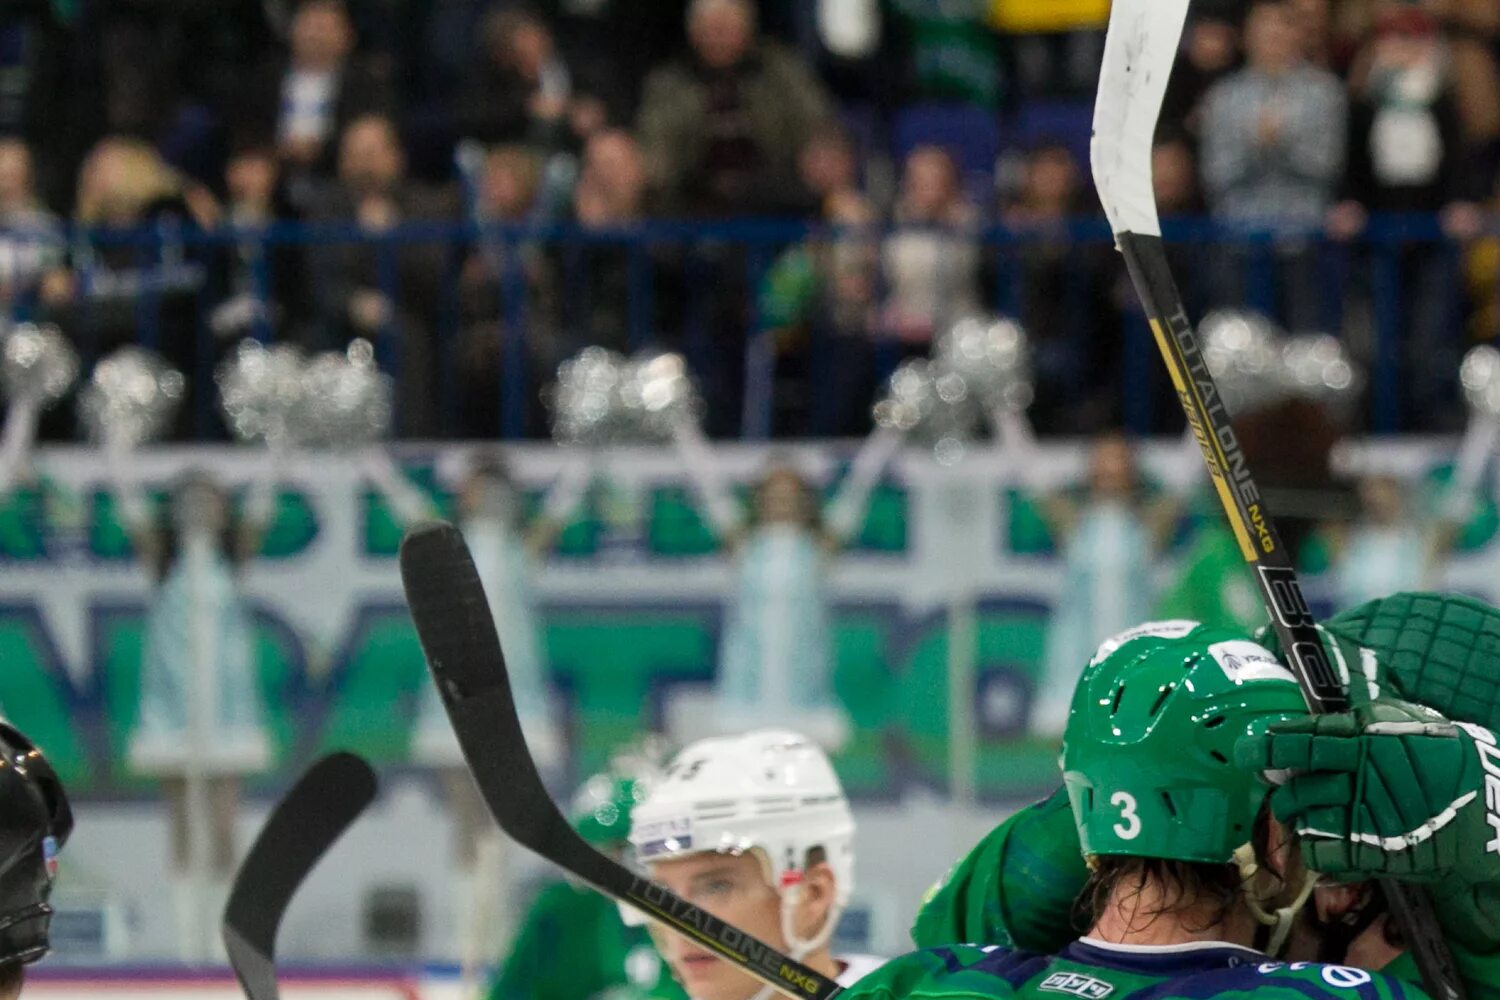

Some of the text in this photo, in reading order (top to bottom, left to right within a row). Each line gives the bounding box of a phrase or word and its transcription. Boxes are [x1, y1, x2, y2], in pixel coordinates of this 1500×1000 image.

[1247, 503, 1276, 554] NXG
[1109, 791, 1142, 840] 3
[778, 963, 820, 996] NXG
